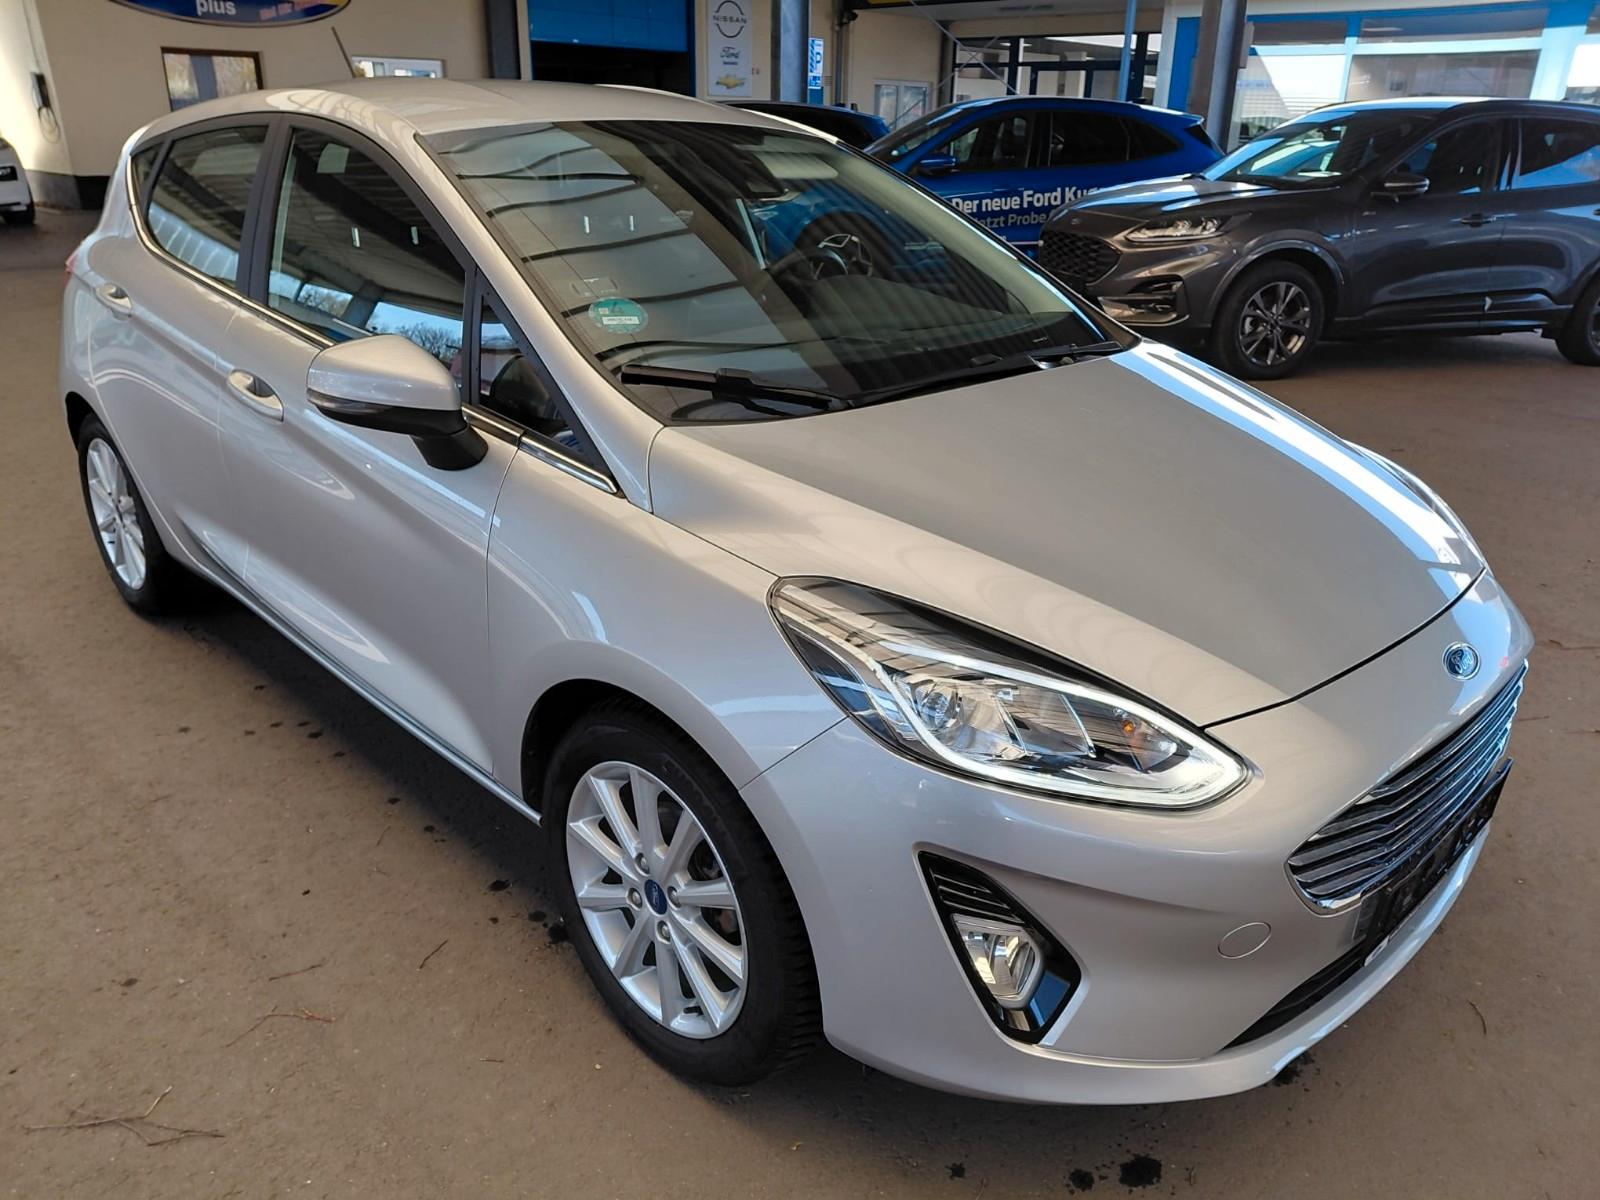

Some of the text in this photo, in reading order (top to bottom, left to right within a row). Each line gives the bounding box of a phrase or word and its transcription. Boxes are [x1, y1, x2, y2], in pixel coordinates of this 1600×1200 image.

[195, 0, 236, 16] plus
[713, 14, 747, 24] NISSAN
[951, 197, 979, 213] Der
[981, 195, 1020, 212] neue
[1022, 186, 1062, 208] Ford
[975, 215, 1006, 228] etzt
